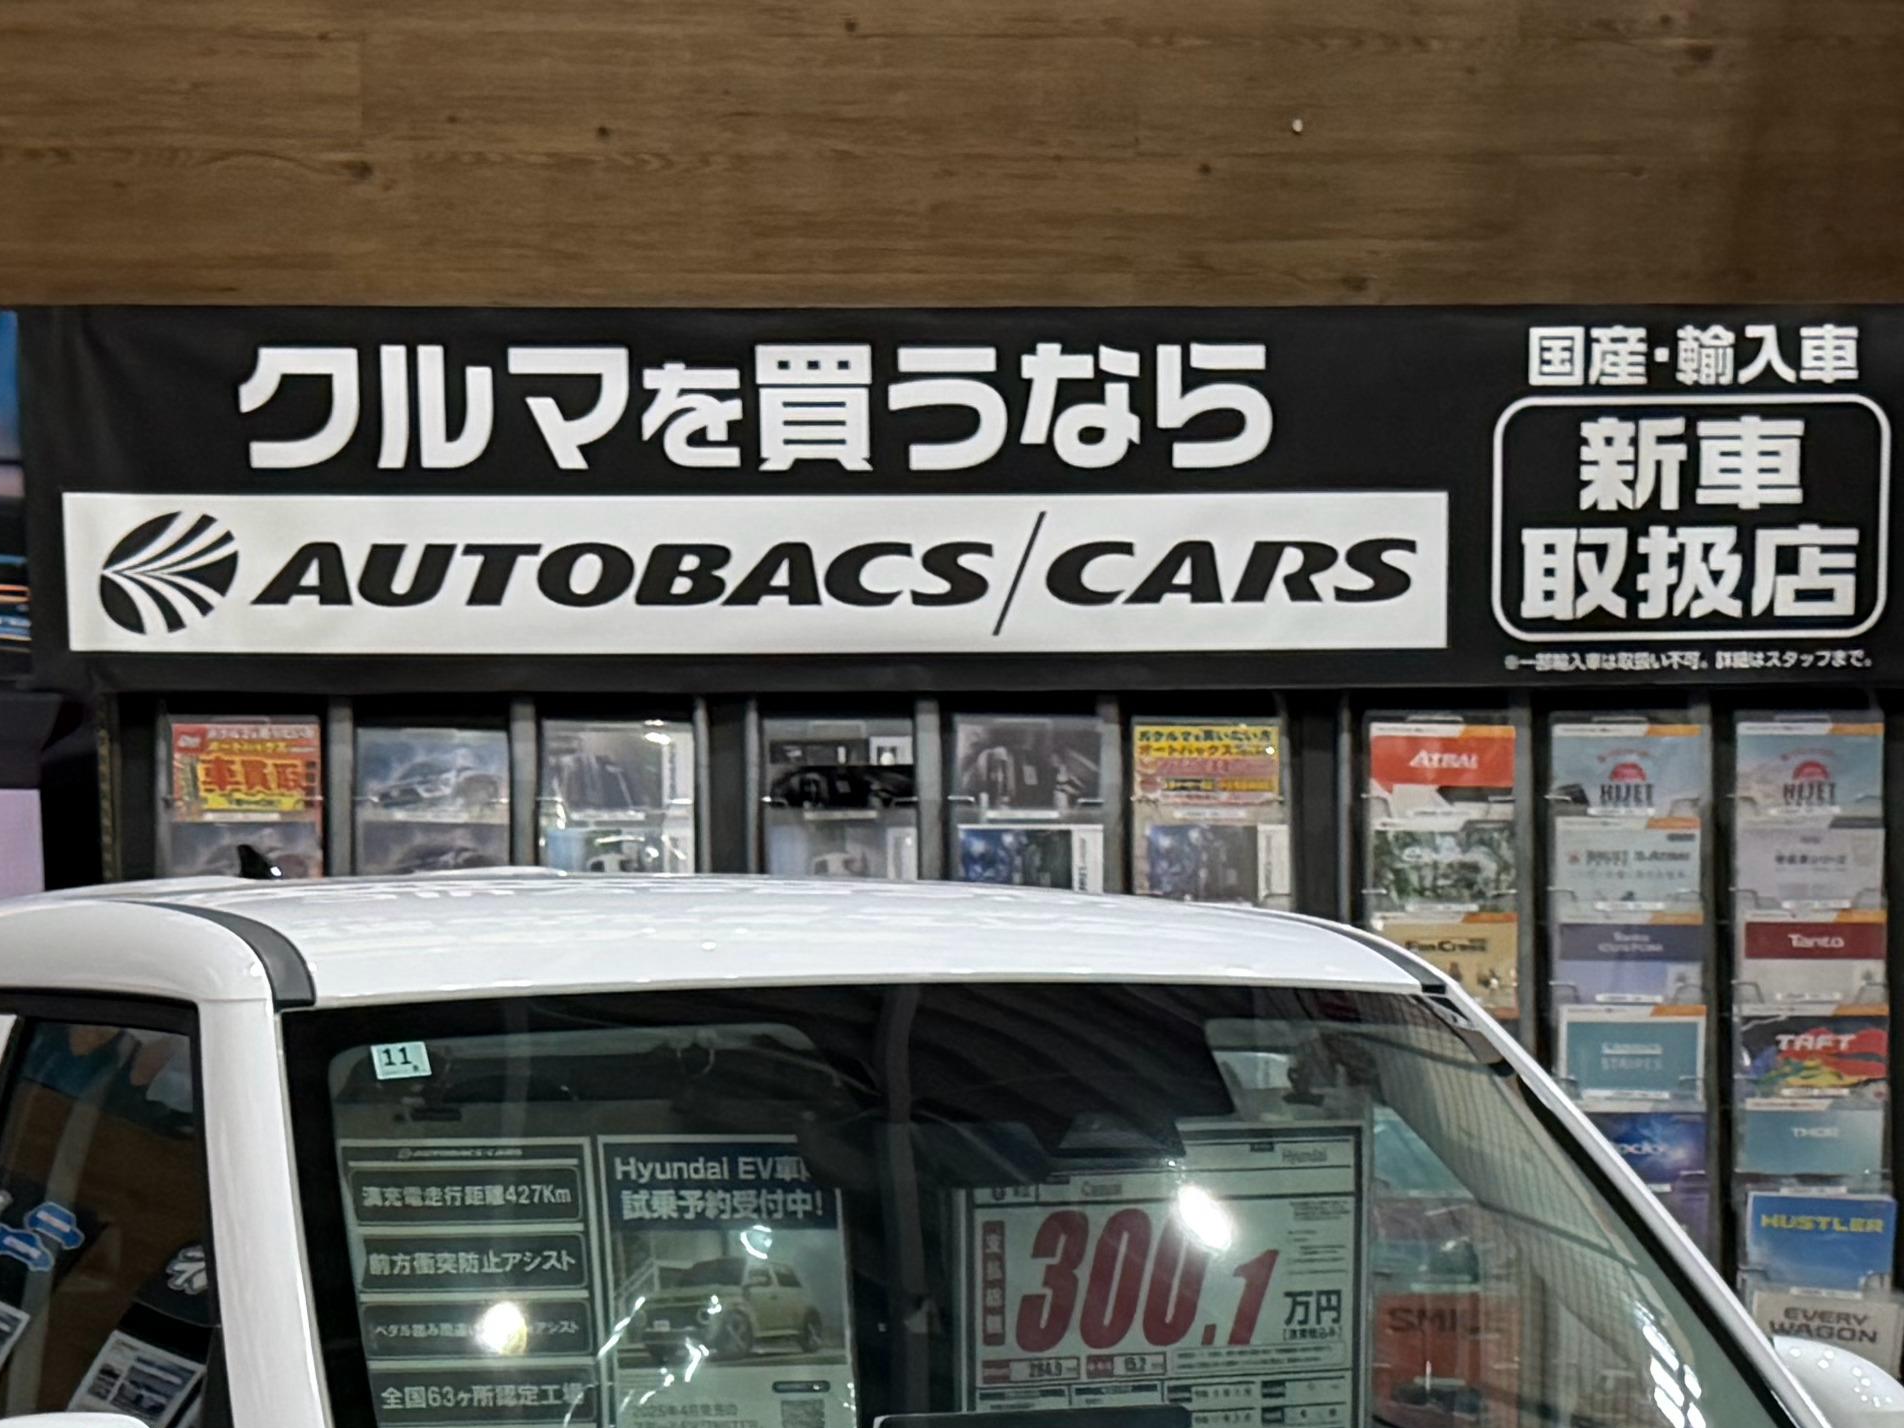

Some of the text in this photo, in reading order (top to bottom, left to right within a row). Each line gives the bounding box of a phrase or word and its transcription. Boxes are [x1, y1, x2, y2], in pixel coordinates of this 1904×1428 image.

[1528, 324, 1859, 387] 国産・輸入車
[237, 343, 1274, 472] クルマを買うなら
[1578, 416, 1806, 512] 新車
[1520, 525, 1861, 622] 取扱店
[1600, 784, 1654, 807] HIJET
[1783, 782, 1836, 806] HIJET
[1776, 1034, 1856, 1051] TAFT
[382, 1047, 411, 1066] 11
[614, 1157, 729, 1183] Hyundai
[620, 1189, 823, 1219] 試乗予約受付中!
[1761, 1213, 1885, 1234] HUSTLER
[1016, 1208, 1279, 1352] 300.1
[1283, 1288, 1342, 1326] 万円
[1784, 1307, 1870, 1325] EVERY
[1770, 1320, 1878, 1344] WAGON
